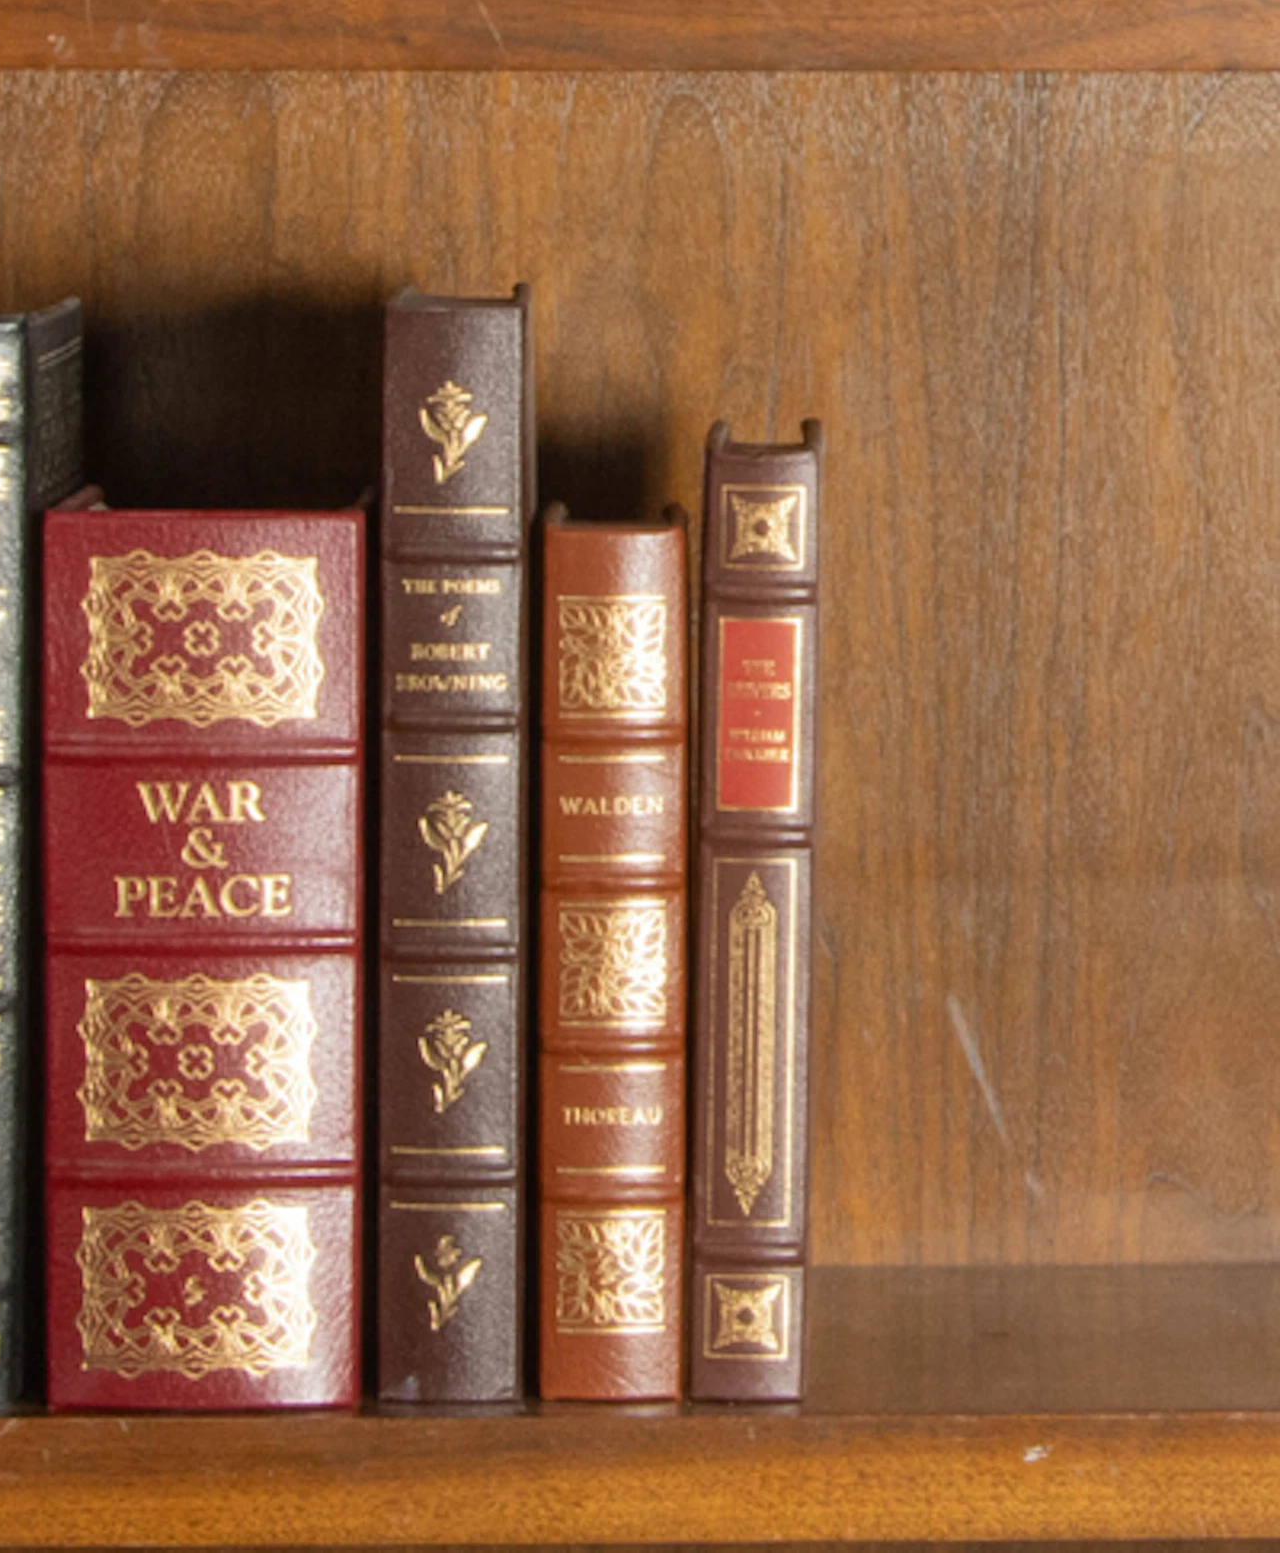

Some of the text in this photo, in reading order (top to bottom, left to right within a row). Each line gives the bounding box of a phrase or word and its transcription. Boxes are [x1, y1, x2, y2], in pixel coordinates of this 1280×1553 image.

[402, 578, 501, 596] THE POEMS
[410, 642, 492, 662] ROBERT
[394, 672, 510, 694] BROWNING
[136, 780, 267, 824] WAR
[558, 796, 665, 817] WALDEN
[180, 826, 230, 870] &
[113, 873, 294, 919] PEACE
[562, 1106, 664, 1128] THOREAU
